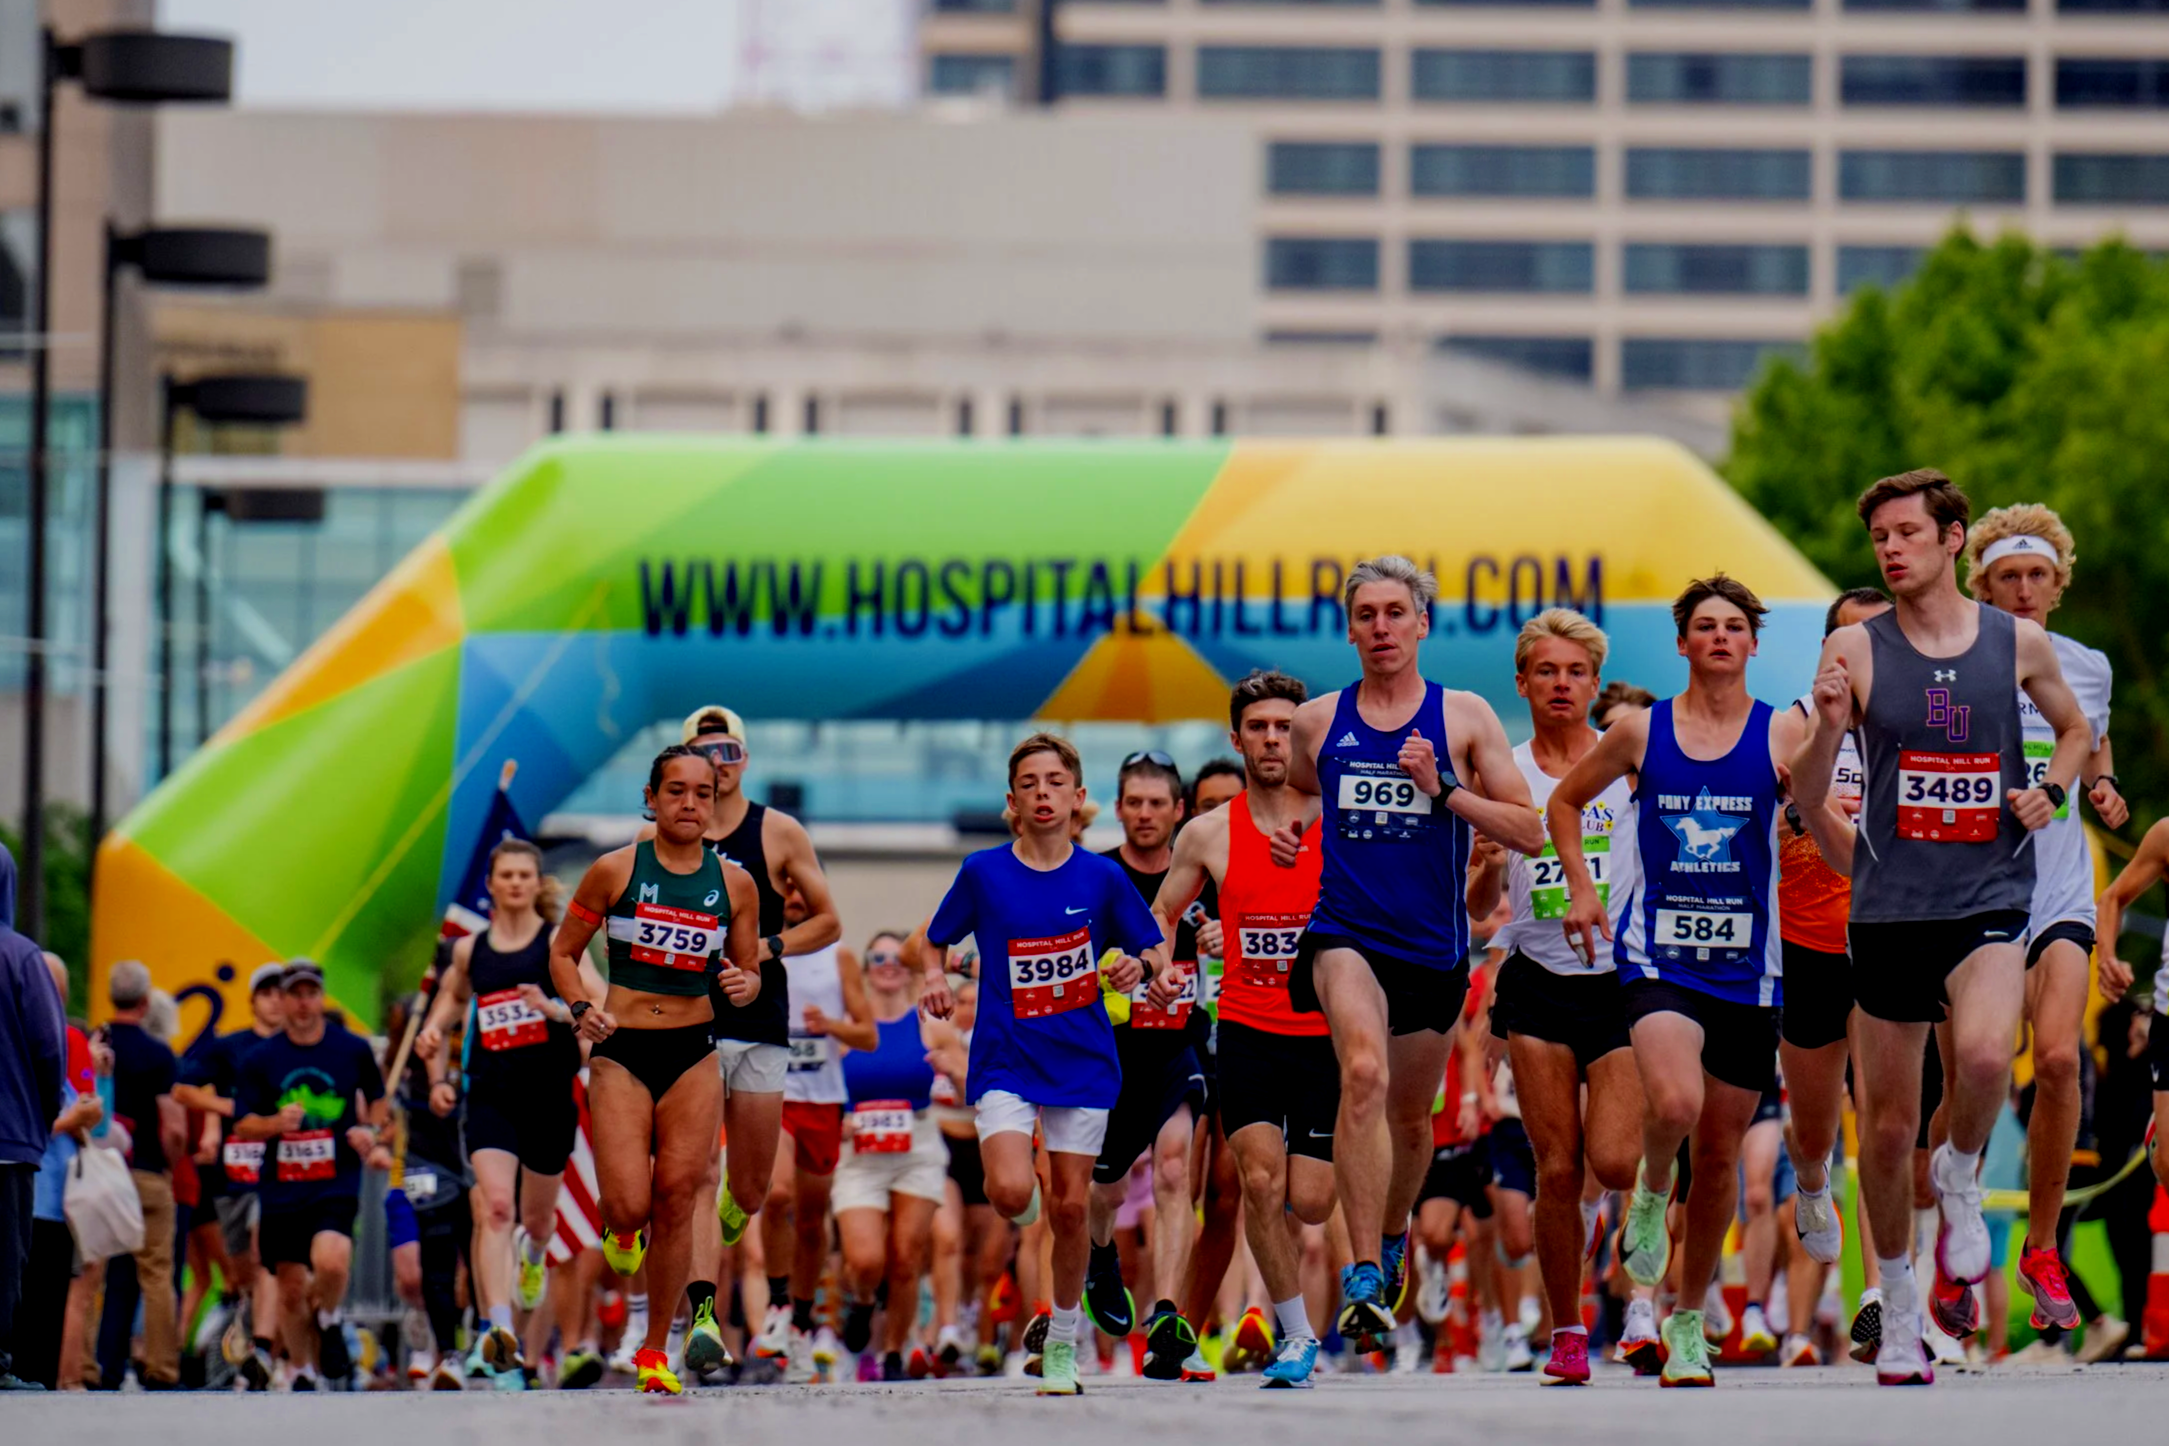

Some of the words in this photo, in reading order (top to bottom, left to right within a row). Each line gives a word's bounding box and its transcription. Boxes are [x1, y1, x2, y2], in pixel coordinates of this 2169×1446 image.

[638, 556, 1605, 640] WWW.HOSPITALHILLR.COM
[1925, 688, 1970, 742] BU
[1349, 761, 1385, 769] HOSPITAL
[1910, 756, 1950, 764] HOSPITAL
[1354, 780, 1415, 807] 969
[1905, 775, 1993, 803] 3489
[1658, 794, 1691, 810] PONY
[1696, 796, 1753, 811] EXPRESS
[1534, 856, 1602, 886] 271
[1670, 861, 1741, 873] ATHLETICS
[644, 905, 678, 917] HOSPITAL
[679, 912, 694, 920] HILL
[1666, 894, 1705, 904] HOSPITAL
[1707, 897, 1725, 905] HILL
[1725, 898, 1743, 906] RUN
[639, 923, 707, 952] 3759
[1016, 940, 1053, 948] HOSPITAL
[1055, 937, 1071, 945] HILL
[1073, 931, 1085, 940] RUN
[1673, 915, 1735, 942] 584
[1245, 931, 1298, 956] 383
[1015, 948, 1089, 984] 3984
[1140, 978, 1194, 998] 322
